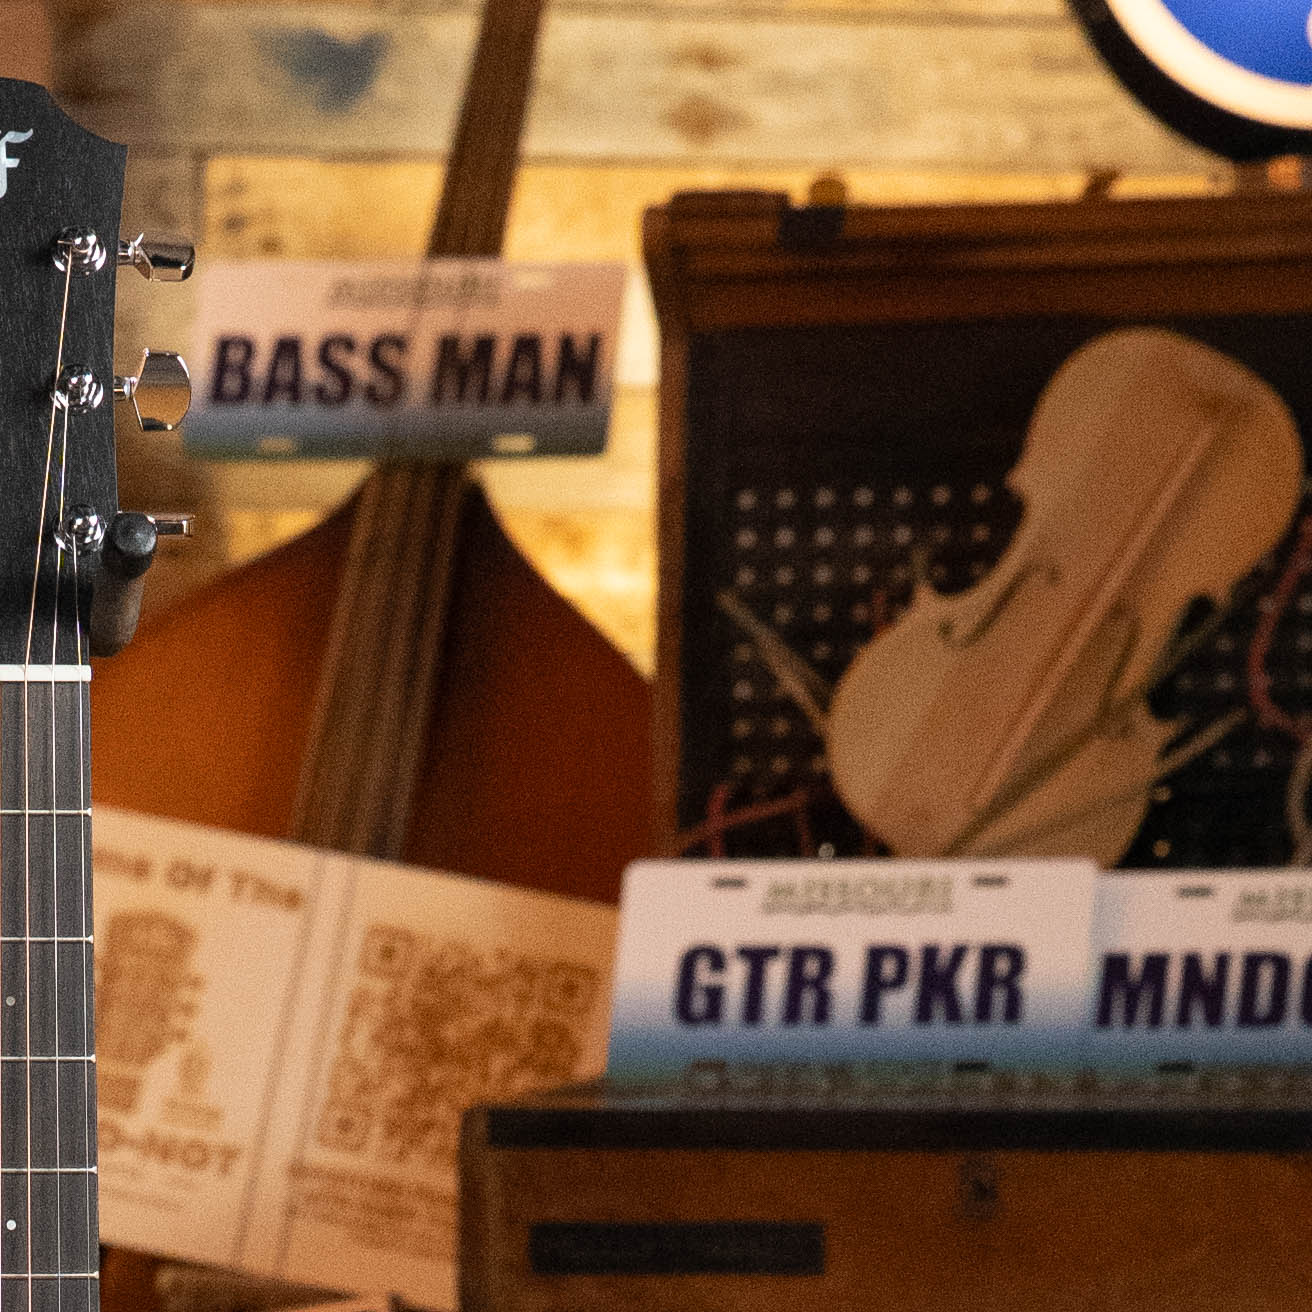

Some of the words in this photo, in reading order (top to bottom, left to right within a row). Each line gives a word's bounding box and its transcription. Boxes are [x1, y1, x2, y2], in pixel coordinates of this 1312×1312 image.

[210, 333, 410, 407] BASS
[432, 332, 605, 406] MAN
[674, 943, 838, 1029] GTR
[857, 943, 1028, 1029] PKR
[1094, 949, 1312, 1032] MND
